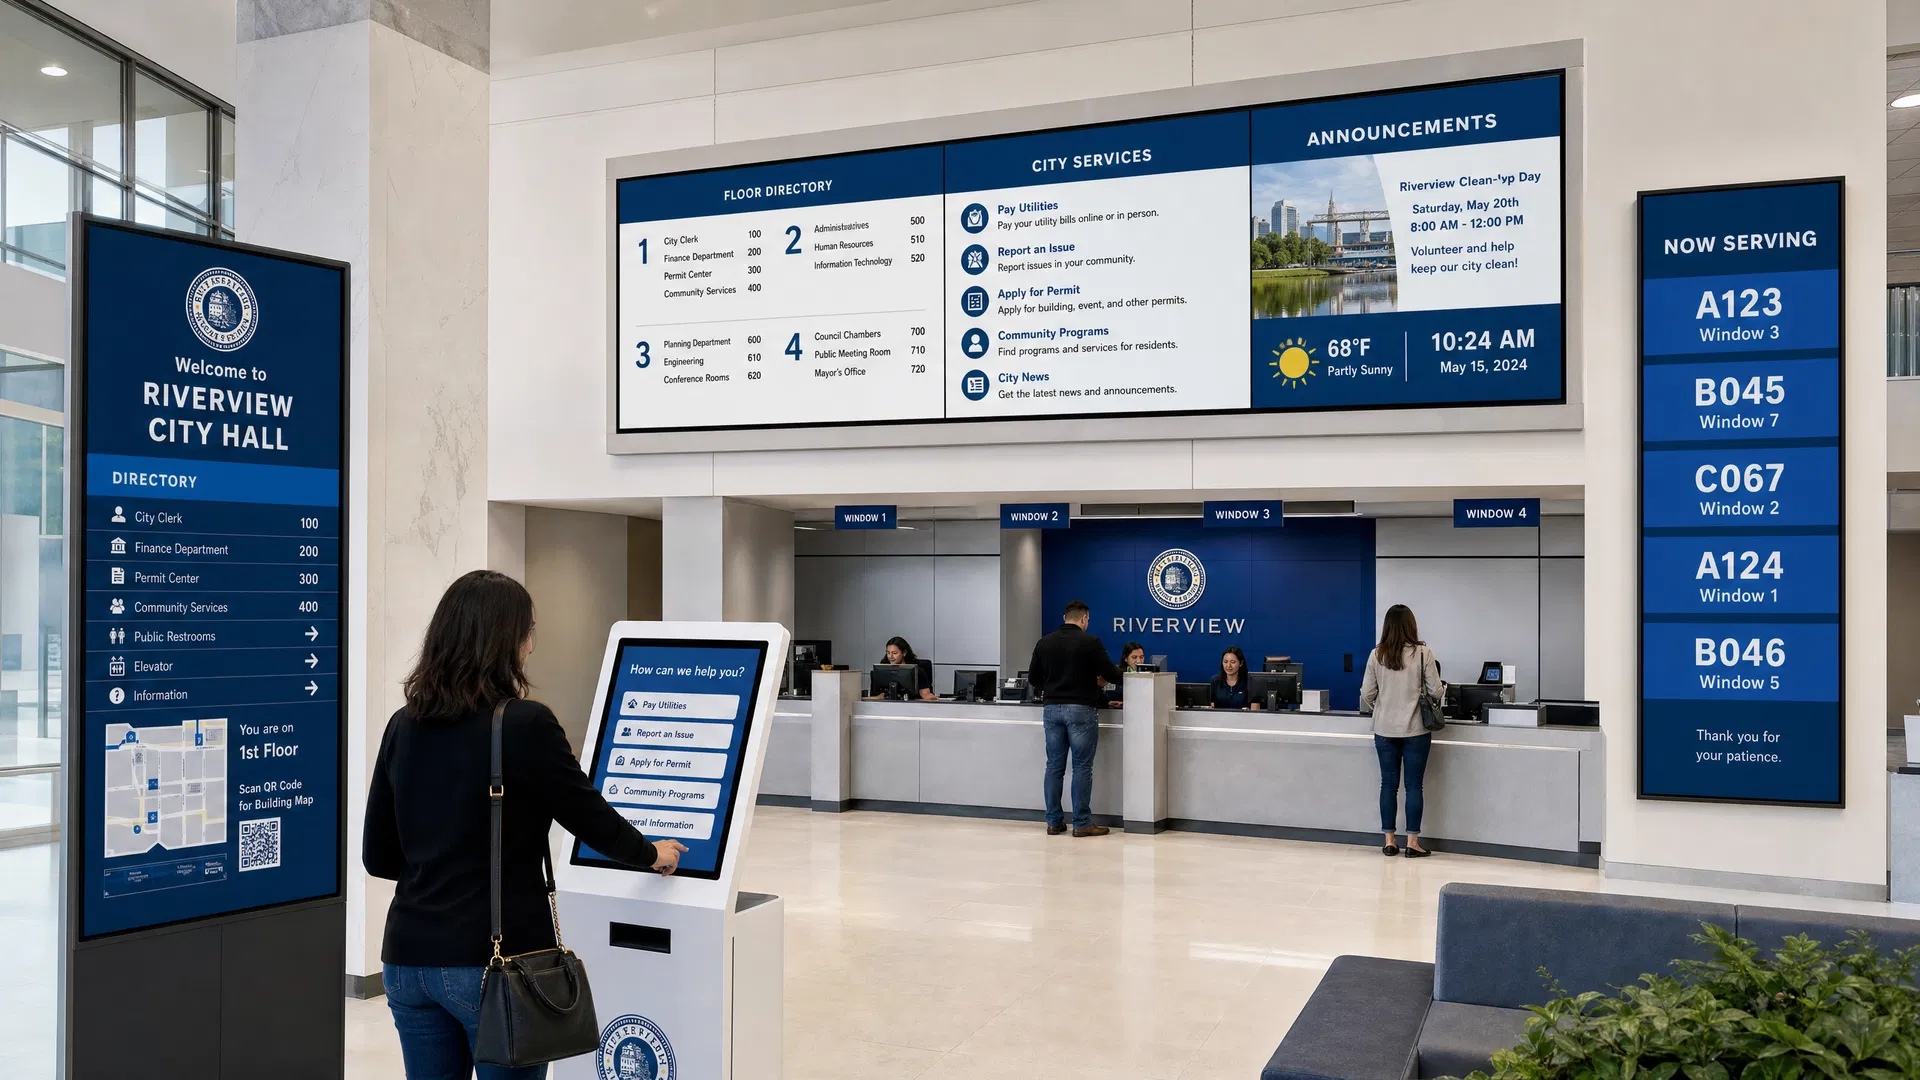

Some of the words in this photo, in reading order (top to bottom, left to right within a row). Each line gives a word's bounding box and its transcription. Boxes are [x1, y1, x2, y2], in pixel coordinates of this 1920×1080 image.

[1306, 113, 1498, 148] ANNOUNCEMENTS
[1032, 158, 1067, 172] CITY
[1074, 149, 1151, 168] SERVICES
[725, 188, 761, 200] FLOOR
[766, 180, 832, 196] DIRECTORY
[998, 205, 1015, 216] Pay
[1020, 201, 1058, 212] Utilities
[1413, 202, 1462, 214] Saturday,
[1467, 200, 1489, 211] May
[1494, 197, 1518, 208] 20th
[1411, 221, 1436, 232] 8:00
[1440, 220, 1458, 230] AM
[1471, 217, 1501, 228] 12:00
[1506, 215, 1523, 226] PM
[786, 226, 801, 254] 2
[1665, 237, 1715, 254] NOW
[1724, 231, 1816, 251] SERVING
[639, 239, 647, 264] 1
[998, 246, 1031, 258] Report
[1050, 244, 1075, 252] Issue
[1411, 246, 1463, 256] Volunteer
[1467, 242, 1486, 253] and
[1491, 241, 1514, 253] help
[815, 260, 852, 269] Information
[854, 257, 892, 266] Technology
[911, 253, 925, 262] 520
[998, 263, 1025, 273] Report
[1027, 262, 1052, 270] issues
[1065, 260, 1083, 269] your
[1086, 255, 1135, 265] community.
[1412, 264, 1436, 275] keep
[1441, 264, 1458, 272] our
[1462, 261, 1481, 272] city
[1486, 258, 1517, 269] clean!
[998, 288, 1026, 300] Apply
[1030, 287, 1043, 296] for
[1048, 285, 1080, 295] Permit
[1696, 288, 1782, 319] A123
[815, 332, 841, 340] Council
[844, 330, 881, 339] Chambers
[911, 327, 925, 335] 700
[998, 329, 1056, 340] Community
[1060, 328, 1109, 339] Programs
[1432, 331, 1491, 351] 10:24
[1500, 329, 1534, 348] AM
[1700, 327, 1764, 341] Window
[1770, 325, 1779, 339] 3
[664, 340, 691, 349] Planning
[693, 338, 730, 348] Department
[748, 335, 761, 344] 600
[785, 333, 802, 360] 4
[999, 347, 1016, 356] Find
[1019, 347, 1059, 357] programs
[1063, 344, 1078, 353] and
[1082, 343, 1117, 352] services
[1121, 342, 1133, 350] for
[1136, 340, 1178, 350] residents.
[1328, 338, 1370, 357] 68°F
[636, 341, 650, 368] 3
[815, 350, 836, 358] Public
[839, 349, 867, 359] Meeting
[870, 348, 890, 356] Room
[911, 346, 925, 354] 710
[175, 357, 246, 379] Welcome
[252, 367, 266, 381] to
[1328, 365, 1357, 377] Partly
[1361, 365, 1393, 376] Sunny
[1441, 361, 1466, 375] May
[1471, 360, 1488, 373] 15,
[1494, 359, 1527, 371] 2024
[664, 375, 703, 383] Conference
[748, 371, 761, 379] 620
[999, 373, 1018, 384] City
[1022, 373, 1049, 381] News
[1696, 376, 1784, 406] B045
[144, 382, 293, 417] RIVERVIEW
[1700, 414, 1764, 428] Window
[1770, 414, 1779, 427] 7
[149, 418, 213, 444] CITY
[223, 424, 288, 450] HALL
[113, 472, 196, 488] DIRECTORY
[1696, 464, 1784, 492] C067
[1052, 511, 1058, 520] 2
[1216, 511, 1259, 519] WINDOW
[1264, 509, 1269, 519] 3
[1467, 509, 1513, 518] WINDOW
[1519, 508, 1526, 518] 4
[1700, 501, 1764, 515] Window
[1770, 501, 1779, 514] 2
[135, 511, 155, 525] City
[158, 512, 182, 523] Clerk
[301, 518, 318, 529] 100
[845, 514, 878, 522] WINDOW
[882, 513, 885, 521] 1
[136, 542, 171, 553] Finance
[175, 543, 228, 556] Department
[300, 546, 318, 557] 200
[1696, 551, 1783, 579] A124
[135, 572, 165, 583] Permit
[169, 572, 199, 583] Center
[300, 573, 318, 584] 300
[1700, 588, 1764, 602] Window
[1771, 589, 1776, 602] 1
[135, 602, 187, 615] Community
[191, 602, 227, 612] Services
[299, 601, 318, 612] 400
[1114, 618, 1245, 633] RIVERVIEW
[135, 631, 163, 642] Public
[168, 631, 215, 641] Restrooms
[1696, 638, 1785, 667] B046
[135, 661, 173, 671] Elevator
[631, 664, 653, 674] How
[695, 666, 716, 679] help
[719, 667, 744, 679] you?
[1700, 675, 1764, 689] Window
[1771, 676, 1779, 689] 5
[134, 689, 187, 701] Information
[643, 701, 656, 710] Pay
[240, 725, 259, 735] You
[263, 726, 278, 734] are
[637, 729, 661, 738] Report
[675, 731, 694, 739] Issue
[1697, 729, 1733, 741] Thank
[1738, 734, 1758, 744] you
[1763, 731, 1780, 742] for
[240, 745, 259, 759] 1st
[264, 743, 298, 757] Floor
[1696, 752, 1722, 762] your
[1727, 751, 1781, 763] patience.
[630, 758, 651, 768] Apply
[666, 760, 691, 768] Permit
[240, 784, 261, 794] Scan
[264, 782, 277, 792] QR
[280, 779, 302, 790] Code
[624, 787, 666, 798] Community
[669, 790, 704, 800] Programs
[239, 801, 252, 811] for
[255, 798, 291, 809] Building
[295, 795, 313, 806] Map
